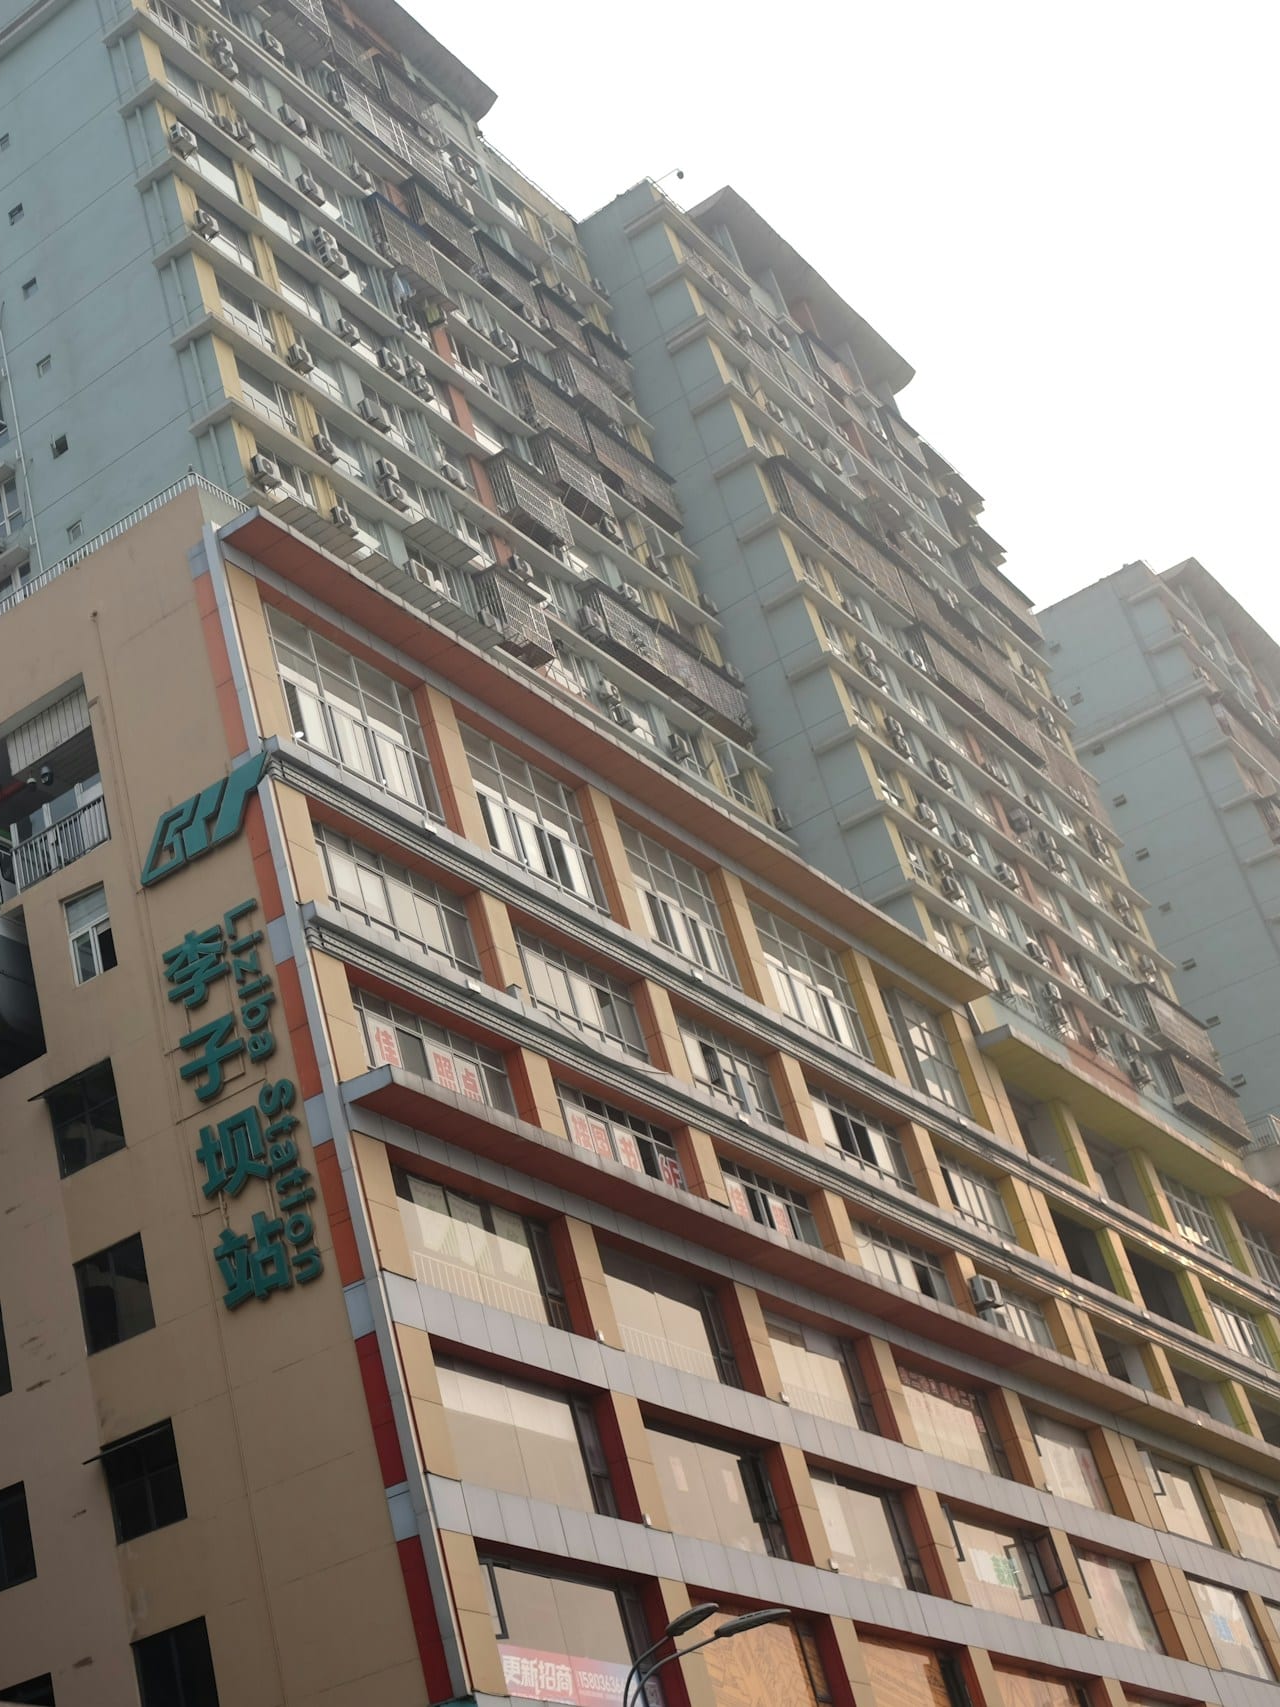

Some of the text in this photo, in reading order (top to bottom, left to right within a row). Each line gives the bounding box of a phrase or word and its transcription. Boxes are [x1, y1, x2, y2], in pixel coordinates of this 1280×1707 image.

[162, 924, 291, 1311] 李子坝站
[223, 898, 324, 1284] Liziba Station
[502, 1655, 573, 1697] 更新招商
